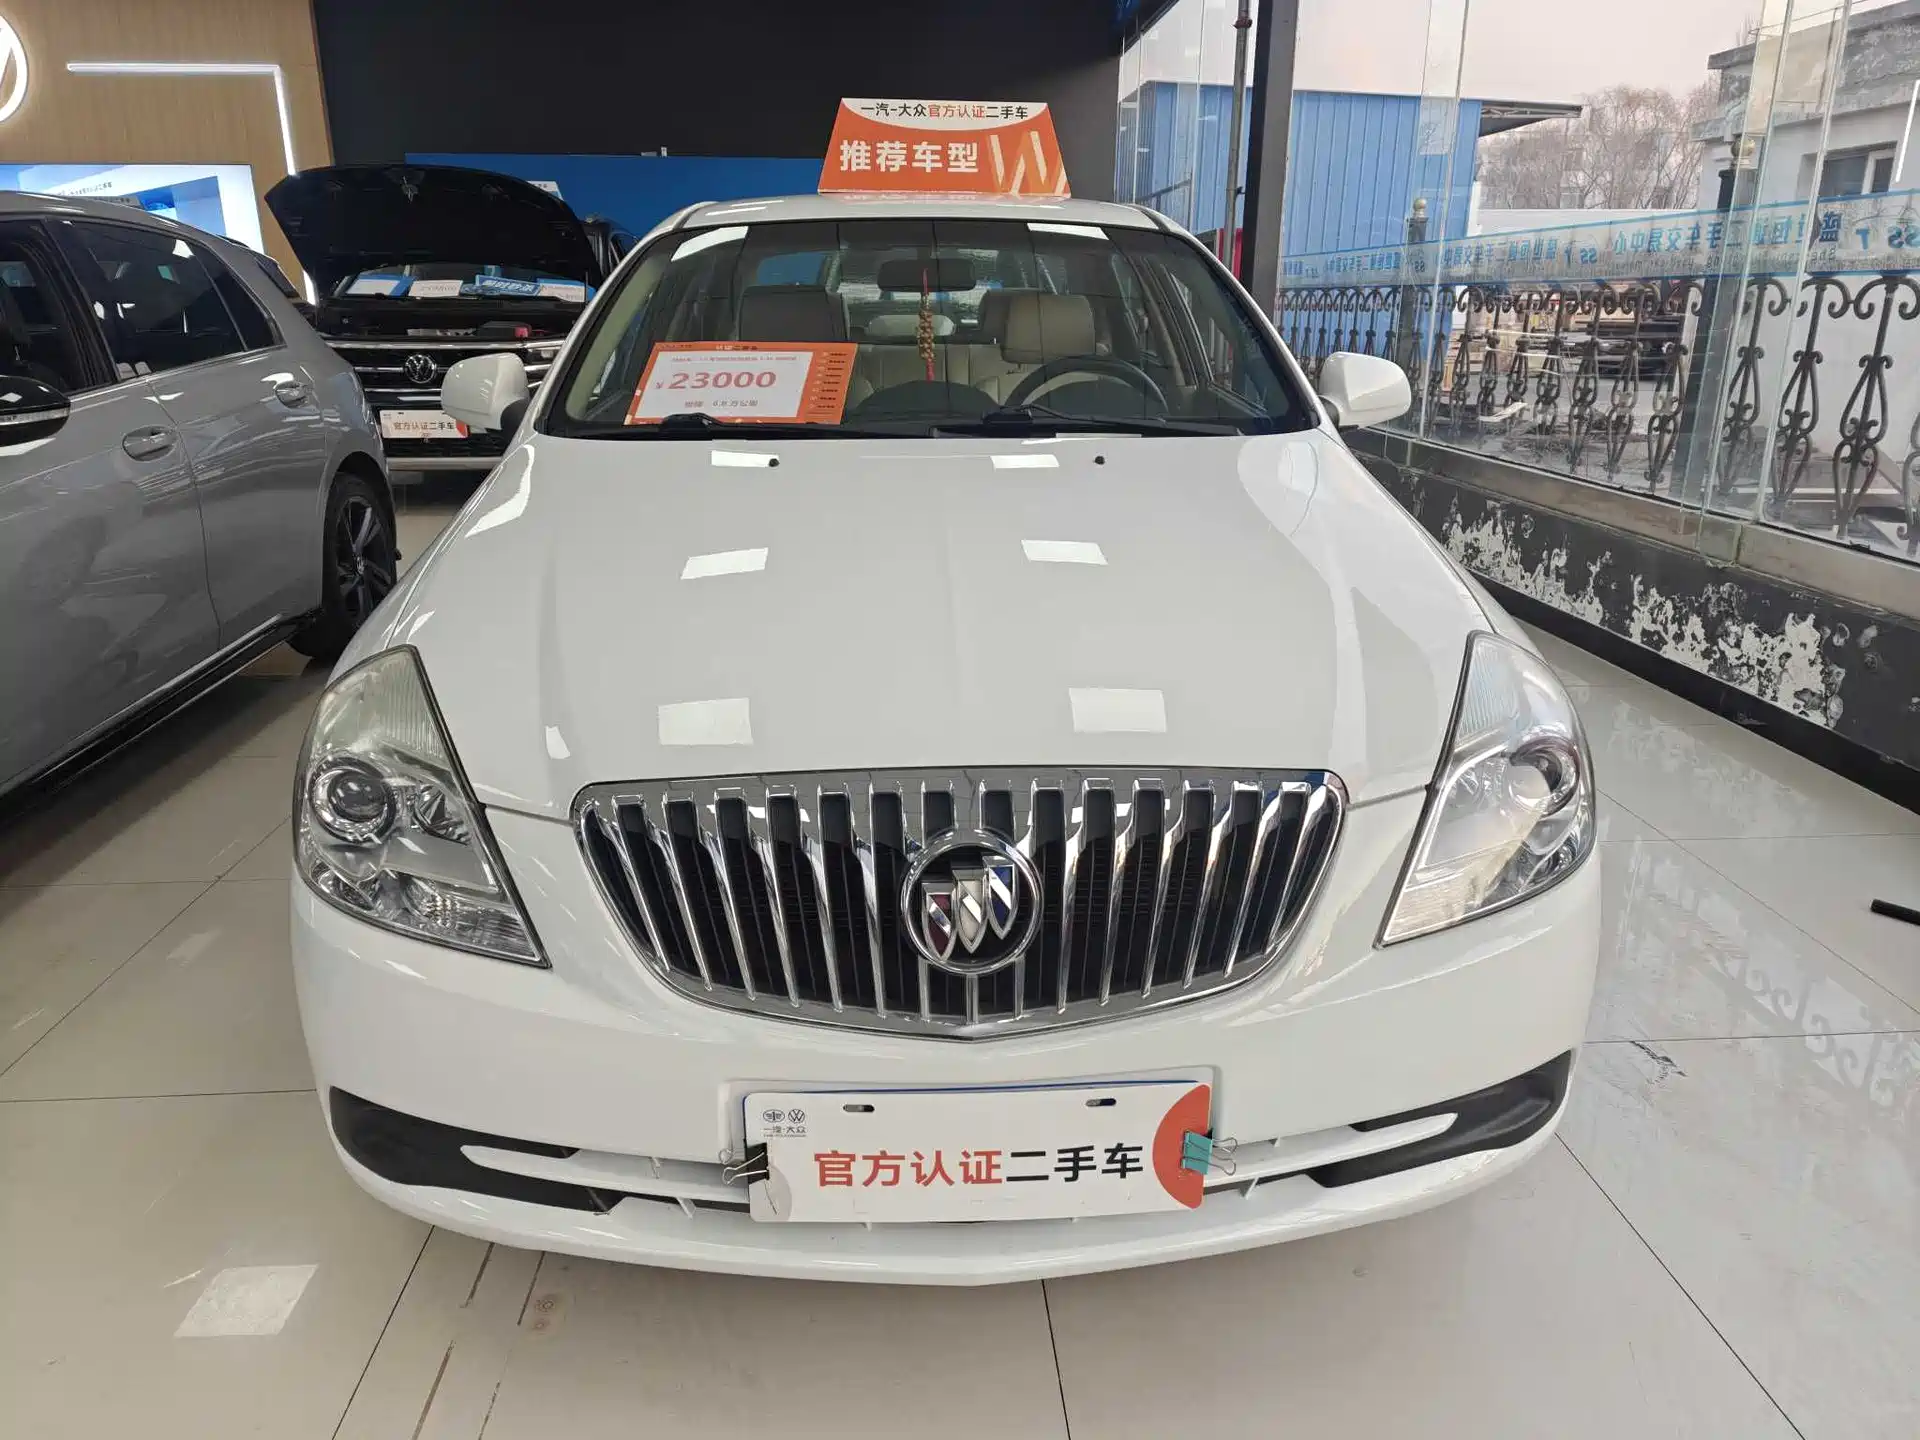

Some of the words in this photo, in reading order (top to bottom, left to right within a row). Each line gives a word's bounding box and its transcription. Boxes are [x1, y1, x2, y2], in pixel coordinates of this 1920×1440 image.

[861, 102, 1028, 119] 一汽-大众官方认证二手车
[839, 139, 979, 173] 推荐车型
[668, 371, 777, 390] 23000
[813, 1142, 1144, 1188] 官方认证二手车
